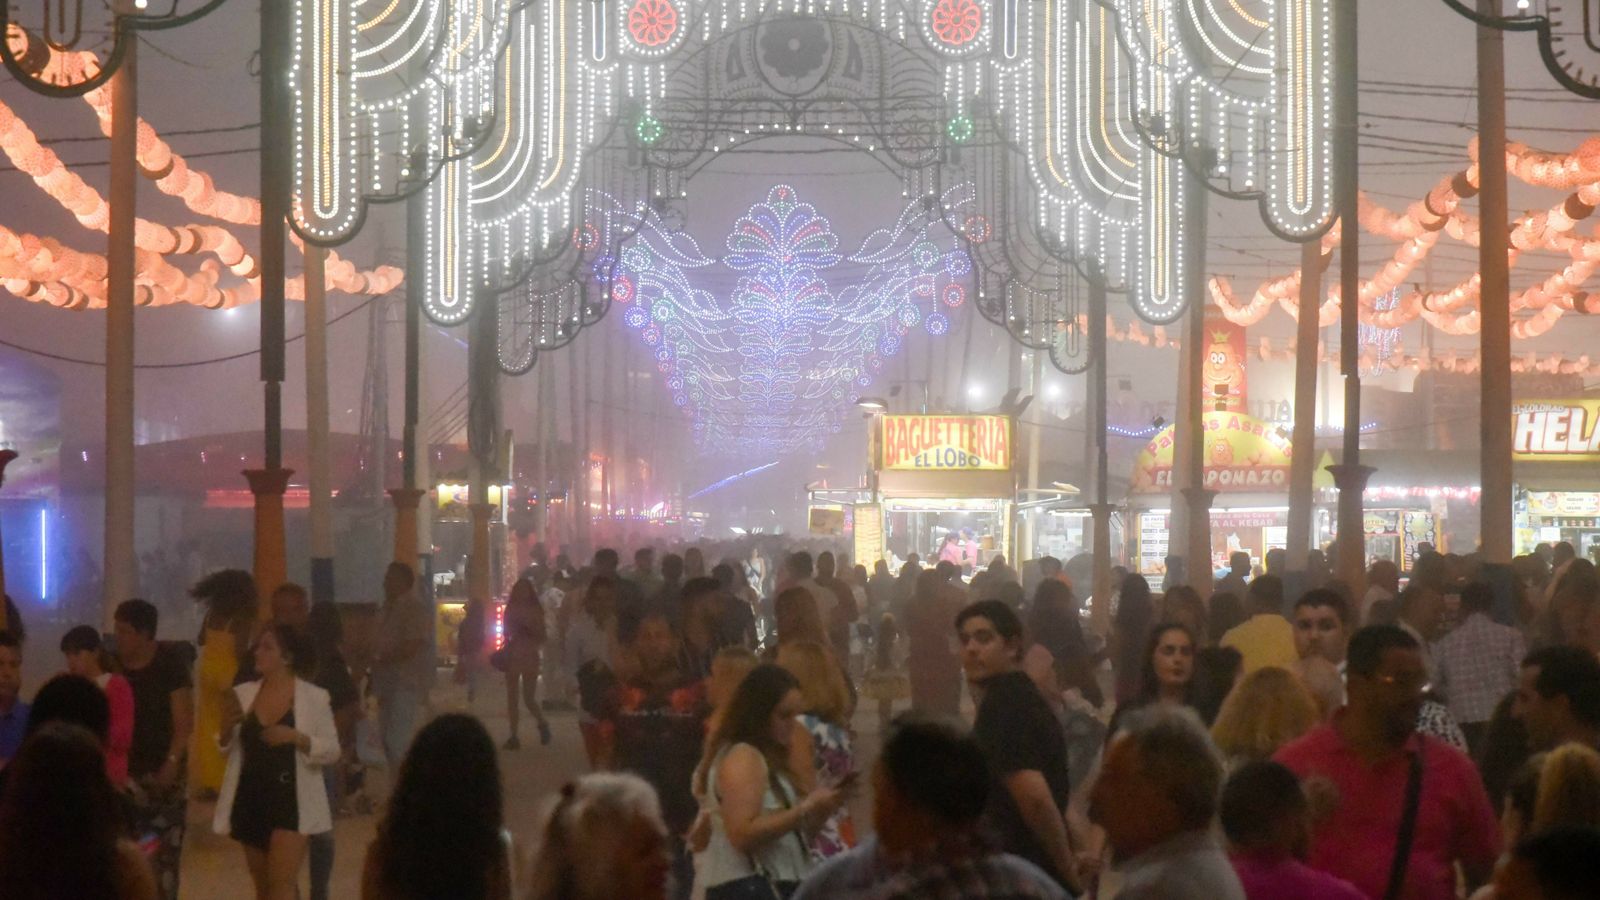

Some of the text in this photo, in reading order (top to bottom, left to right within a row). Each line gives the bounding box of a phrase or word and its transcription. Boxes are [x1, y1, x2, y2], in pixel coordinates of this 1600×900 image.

[885, 416, 1008, 467] BAGUETTERIA
[1227, 415, 1293, 458] Asas
[915, 448, 981, 467] EL LOBO
[1203, 469, 1286, 487] PONAZO
